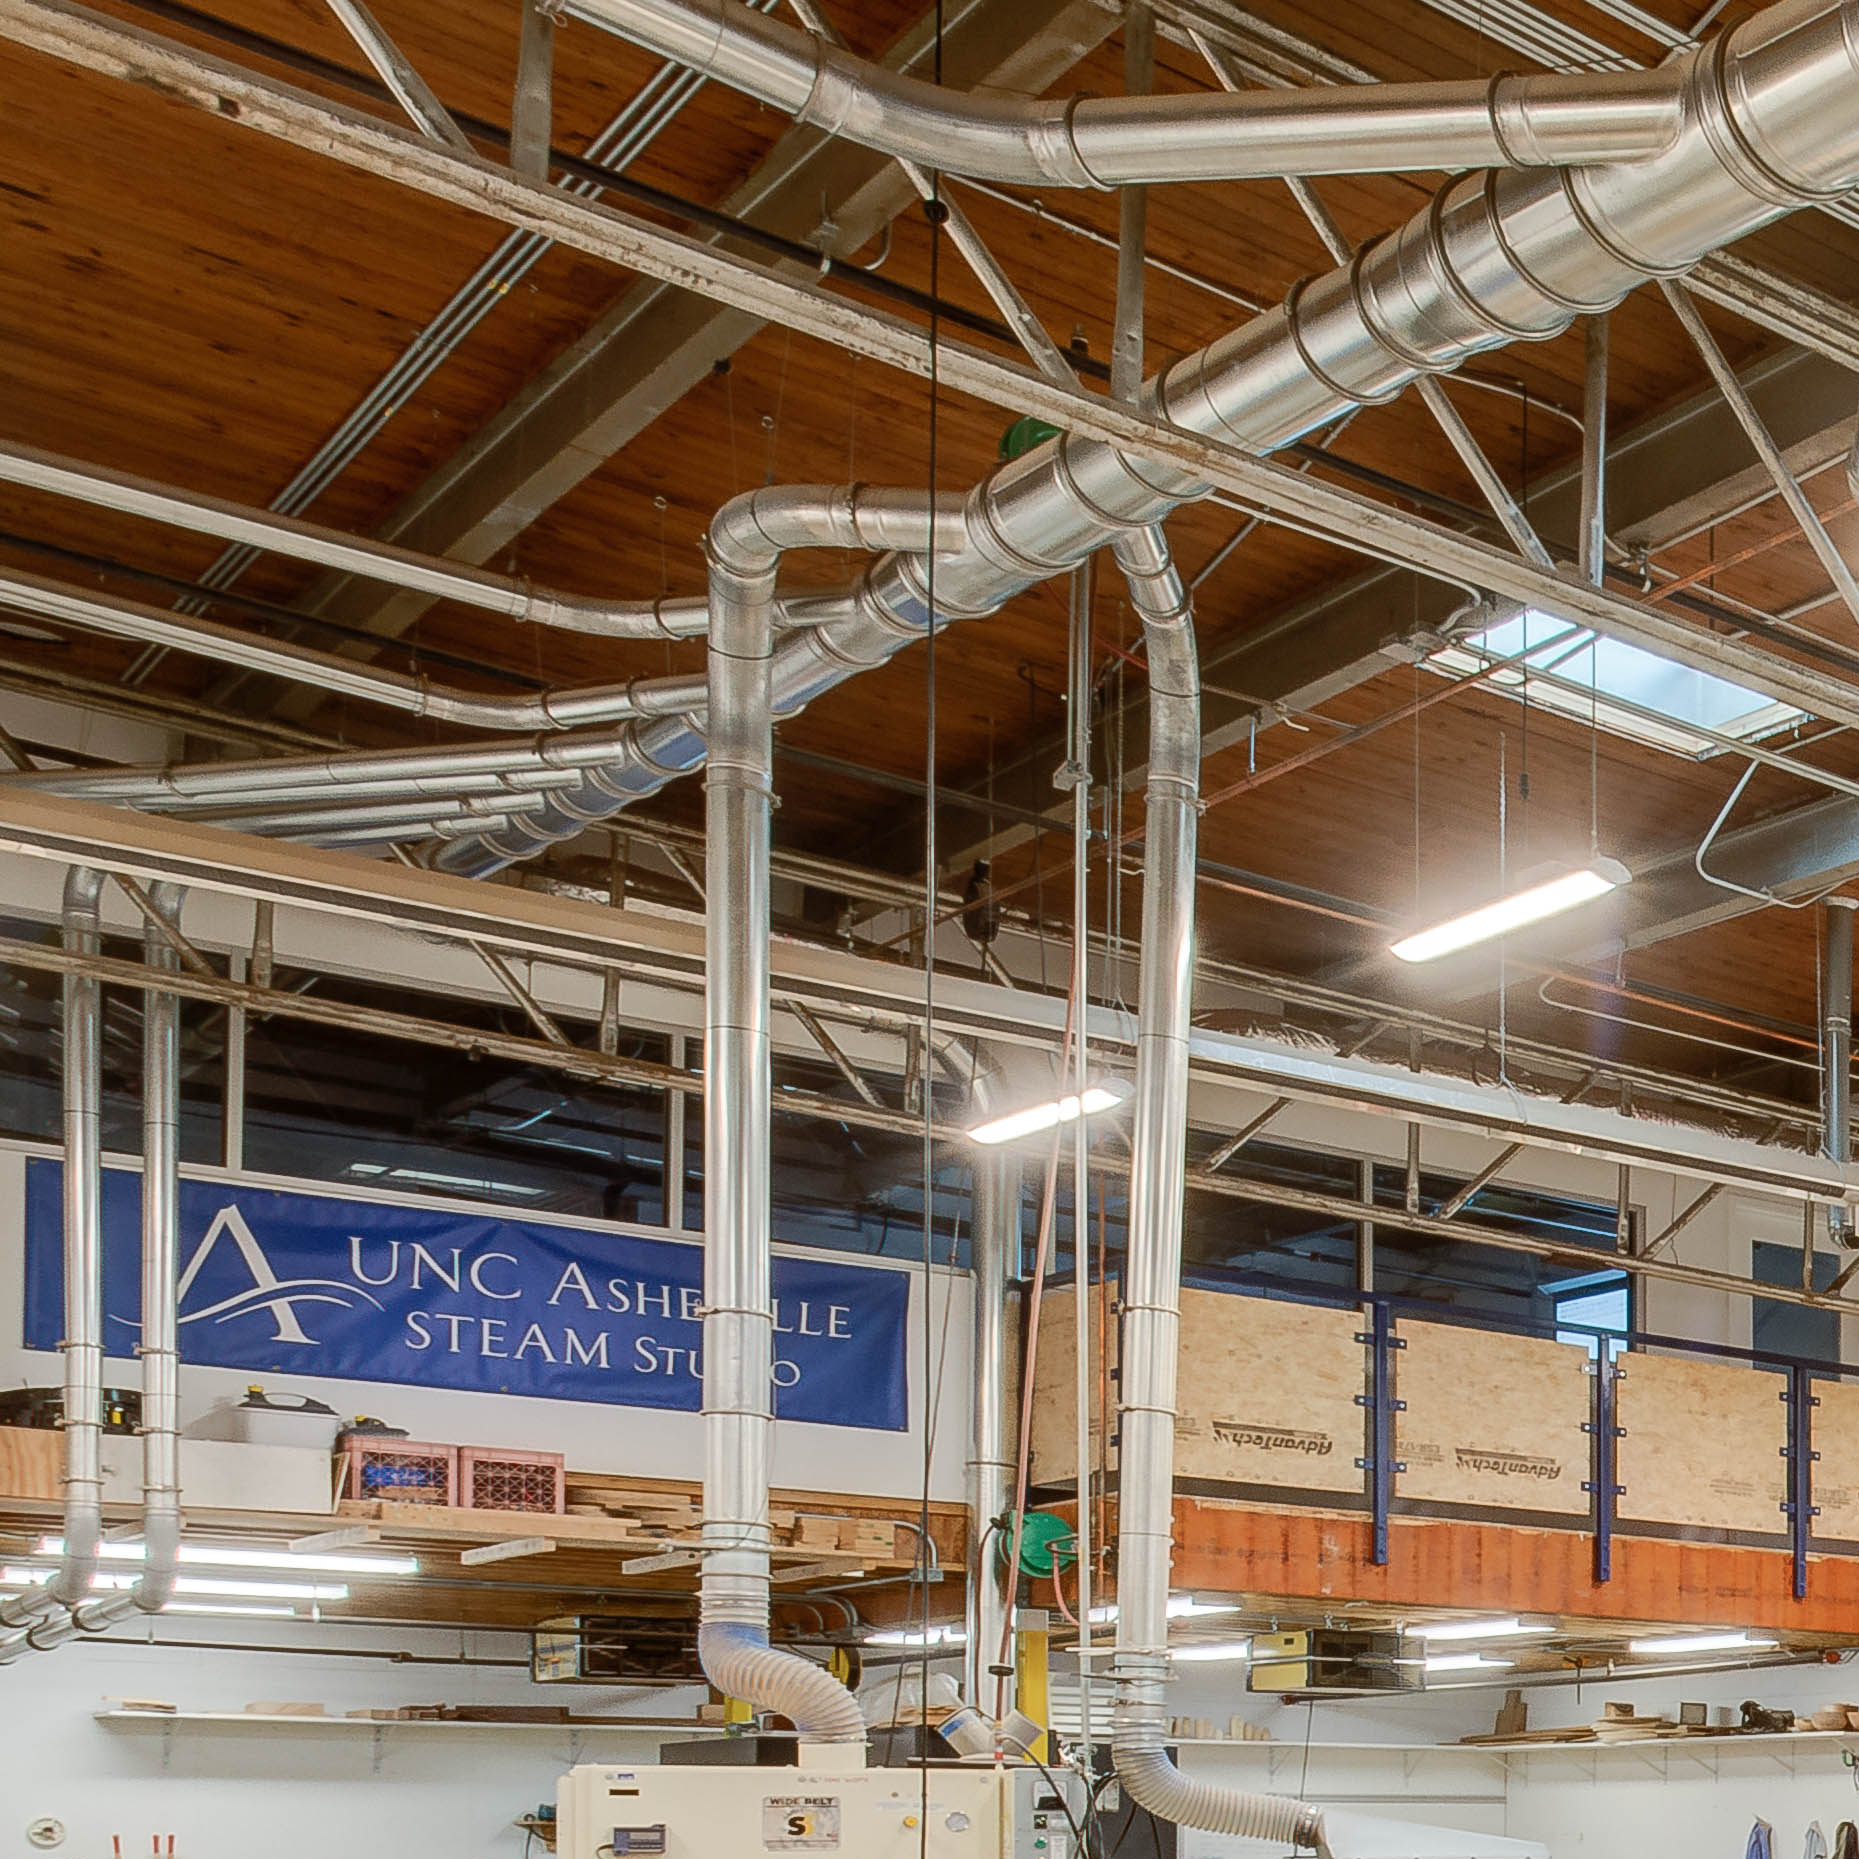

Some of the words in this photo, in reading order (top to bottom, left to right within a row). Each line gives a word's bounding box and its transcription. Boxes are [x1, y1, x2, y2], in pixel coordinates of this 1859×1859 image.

[348, 1235, 522, 1300] UNC
[546, 1261, 853, 1340] ASHELLE
[404, 1310, 611, 1369] STEAM
[633, 1336, 802, 1388] STUO
